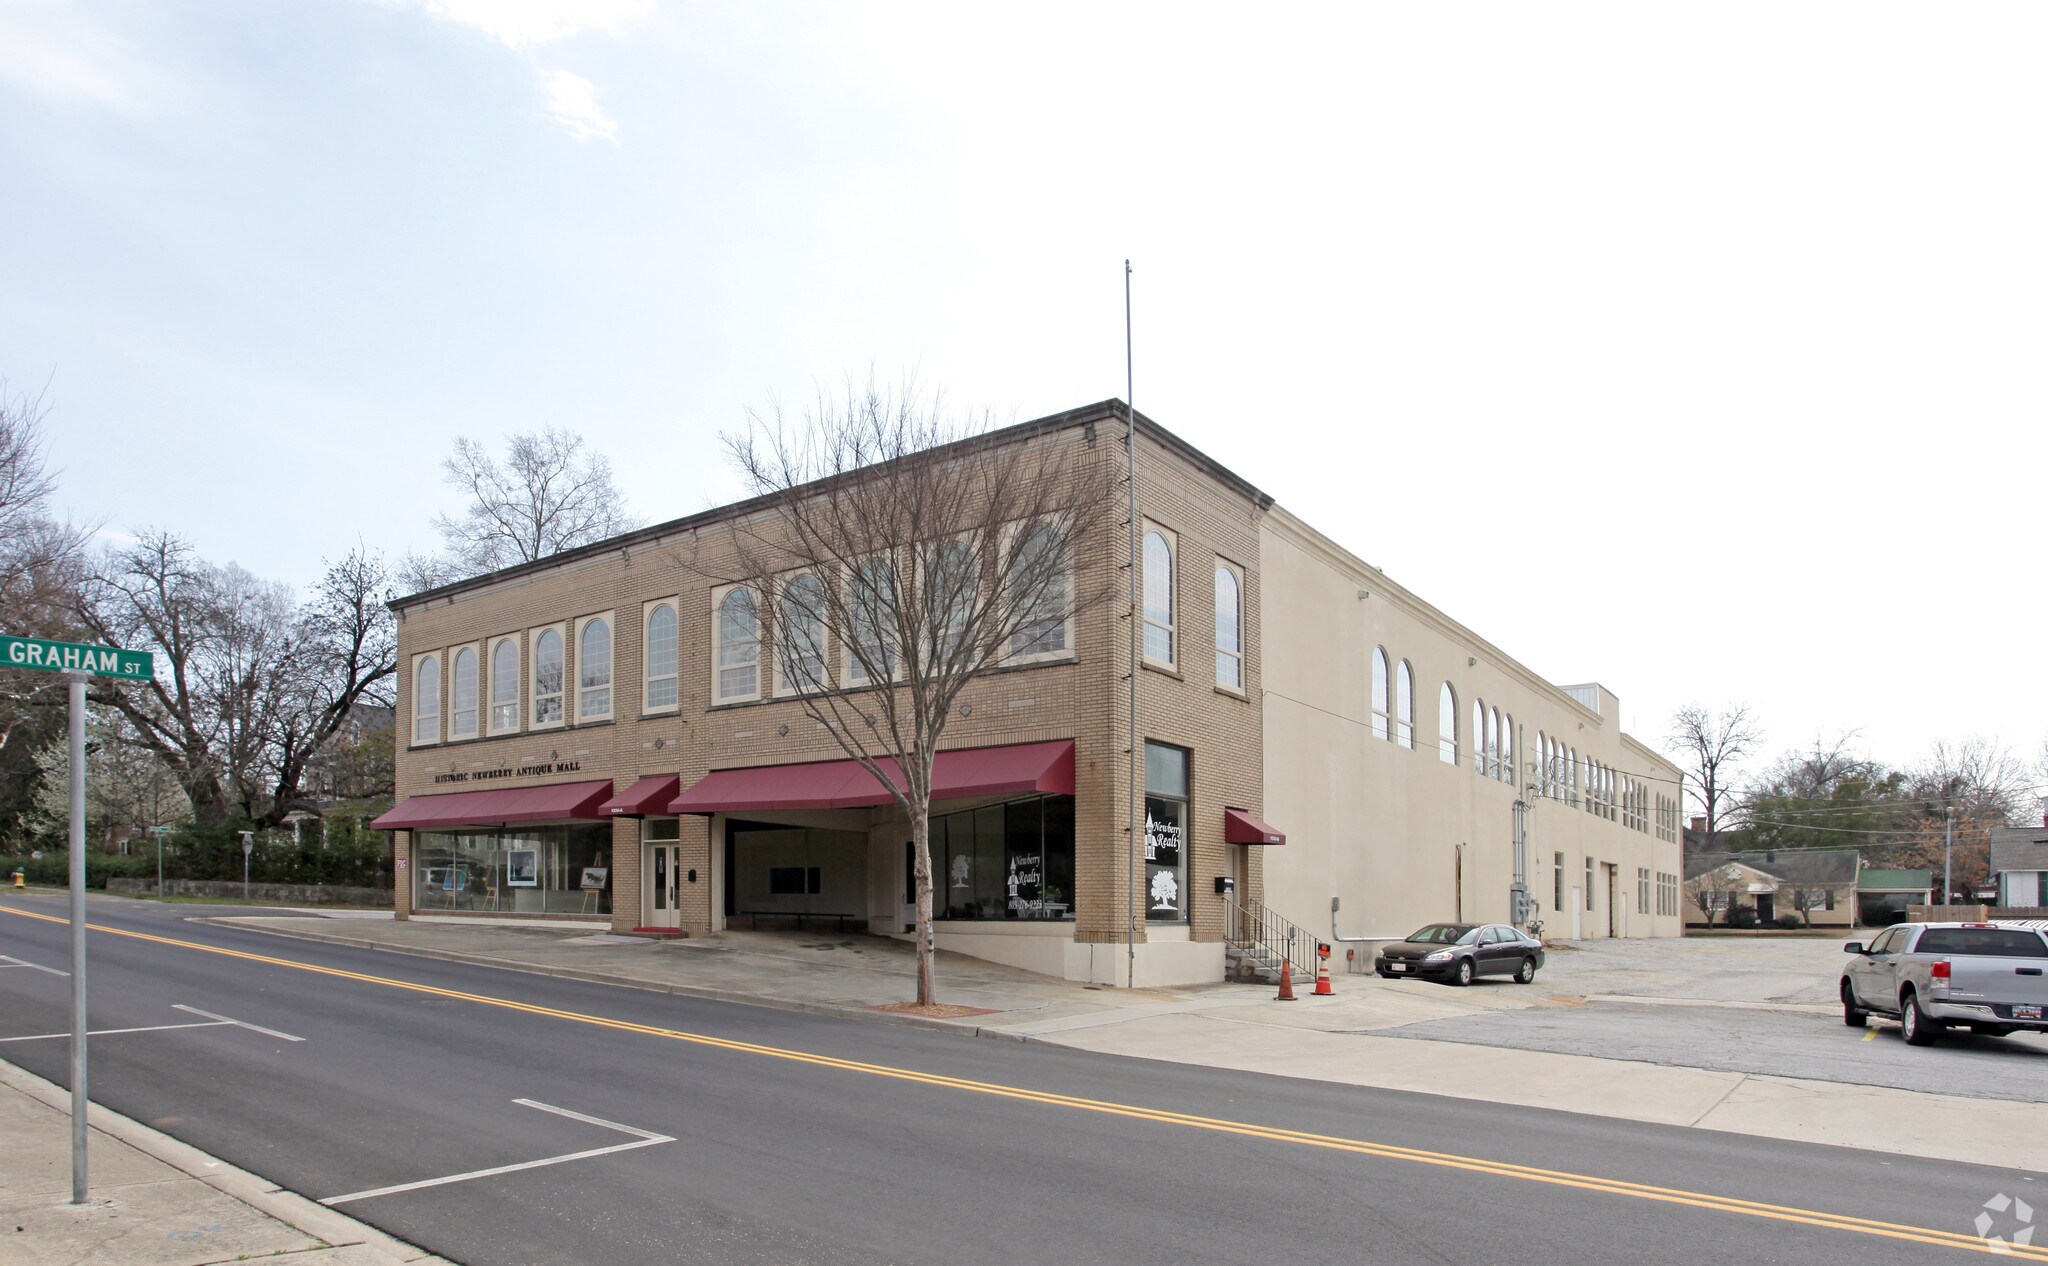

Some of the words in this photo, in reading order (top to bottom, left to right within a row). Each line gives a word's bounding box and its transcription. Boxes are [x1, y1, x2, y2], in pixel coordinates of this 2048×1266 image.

[9, 641, 118, 673] GRAHAM
[124, 662, 141, 675] ST
[434, 772, 468, 784] HISTORIC
[472, 768, 512, 780] NEWBERRY
[516, 764, 552, 776] ANTIQUE
[556, 761, 580, 773] MALL
[1153, 821, 1182, 837] Newberry
[1157, 833, 1182, 852] Realty
[1015, 852, 1040, 868] Newberry
[1018, 868, 1041, 887] Realty
